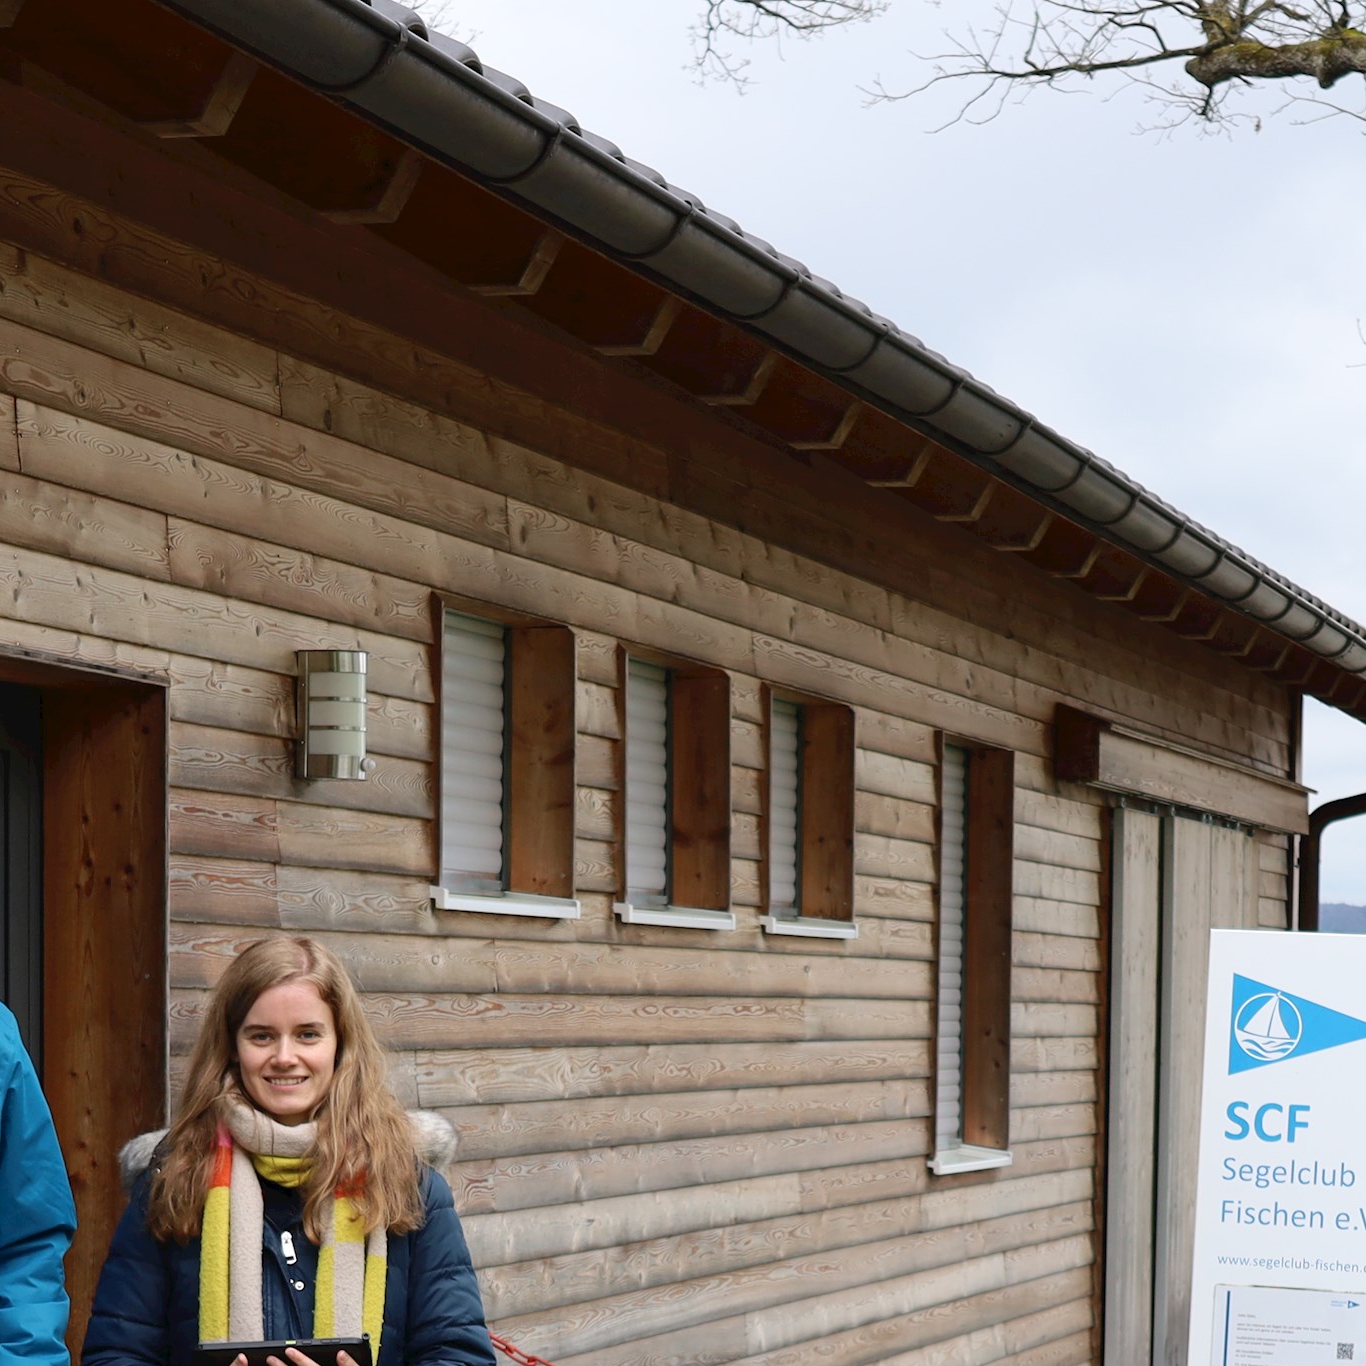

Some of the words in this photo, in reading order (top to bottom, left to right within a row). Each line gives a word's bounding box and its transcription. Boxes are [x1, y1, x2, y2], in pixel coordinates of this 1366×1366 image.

[1223, 1100, 1312, 1143] SCF
[1221, 1156, 1356, 1189] Segelclub
[1221, 1199, 1325, 1230] Fischen
